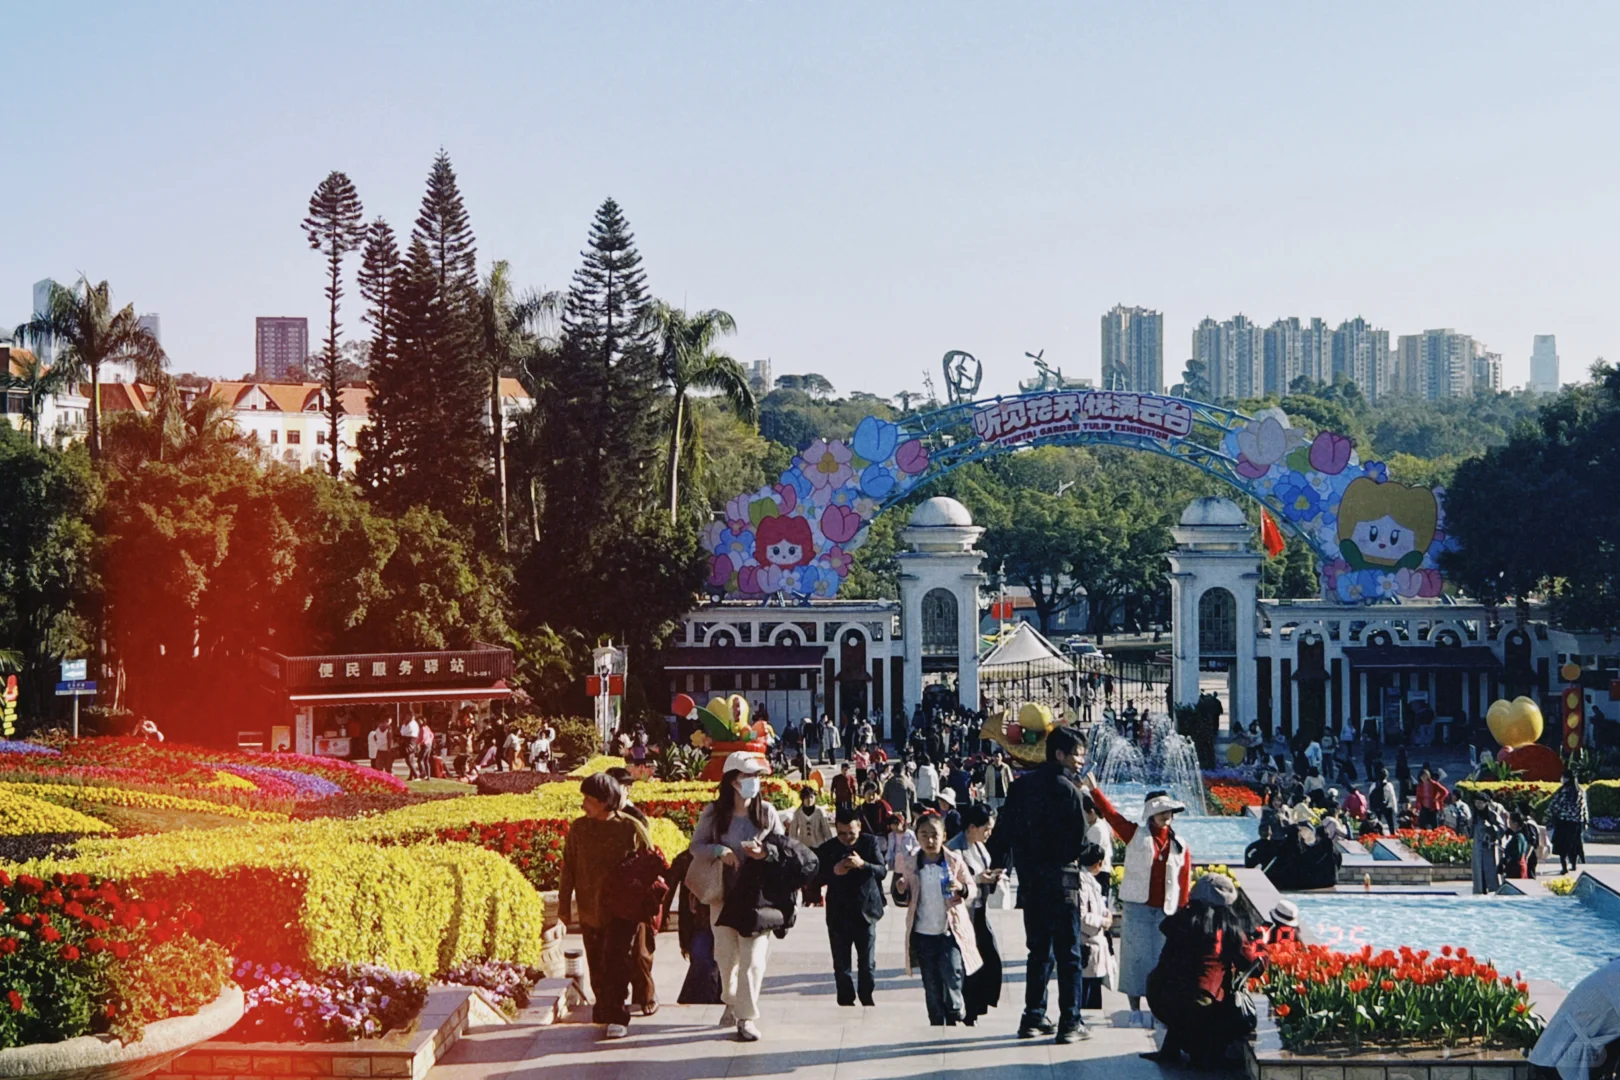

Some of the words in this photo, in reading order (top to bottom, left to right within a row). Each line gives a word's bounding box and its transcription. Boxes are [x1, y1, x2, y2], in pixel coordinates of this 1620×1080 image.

[976, 394, 1080, 441] 听见花开
[1083, 393, 1192, 436] 悦满云台
[1002, 430, 1037, 446] YUNTAI
[1039, 424, 1080, 436] GARDEN
[1083, 422, 1111, 431] TULIP
[1114, 424, 1169, 441] EXHIBITION
[318, 658, 465, 678] 便民服务驿站
